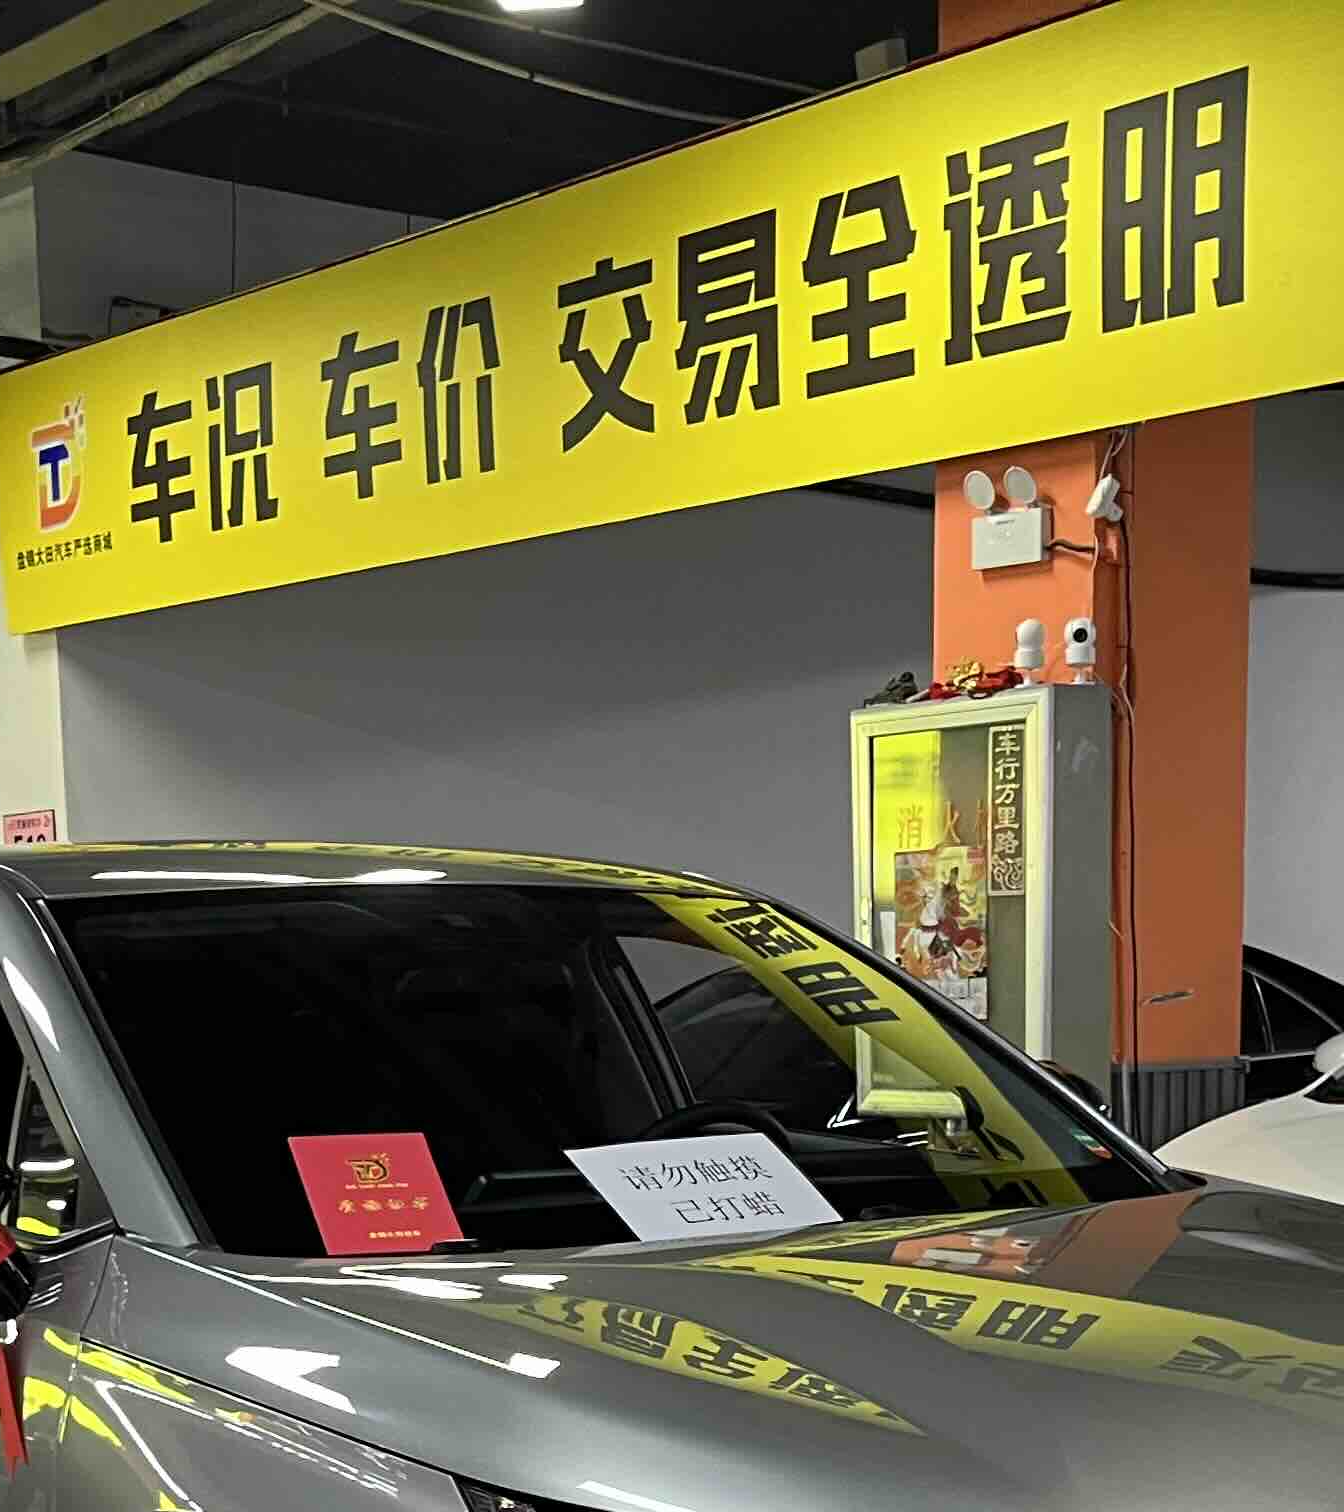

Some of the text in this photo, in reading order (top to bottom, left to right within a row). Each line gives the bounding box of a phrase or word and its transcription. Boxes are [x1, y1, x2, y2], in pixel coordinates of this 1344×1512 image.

[128, 361, 280, 544] 车况
[321, 295, 501, 499] 车价
[558, 65, 1250, 453] 交易全透明
[618, 1152, 773, 1190] 请勿触摸
